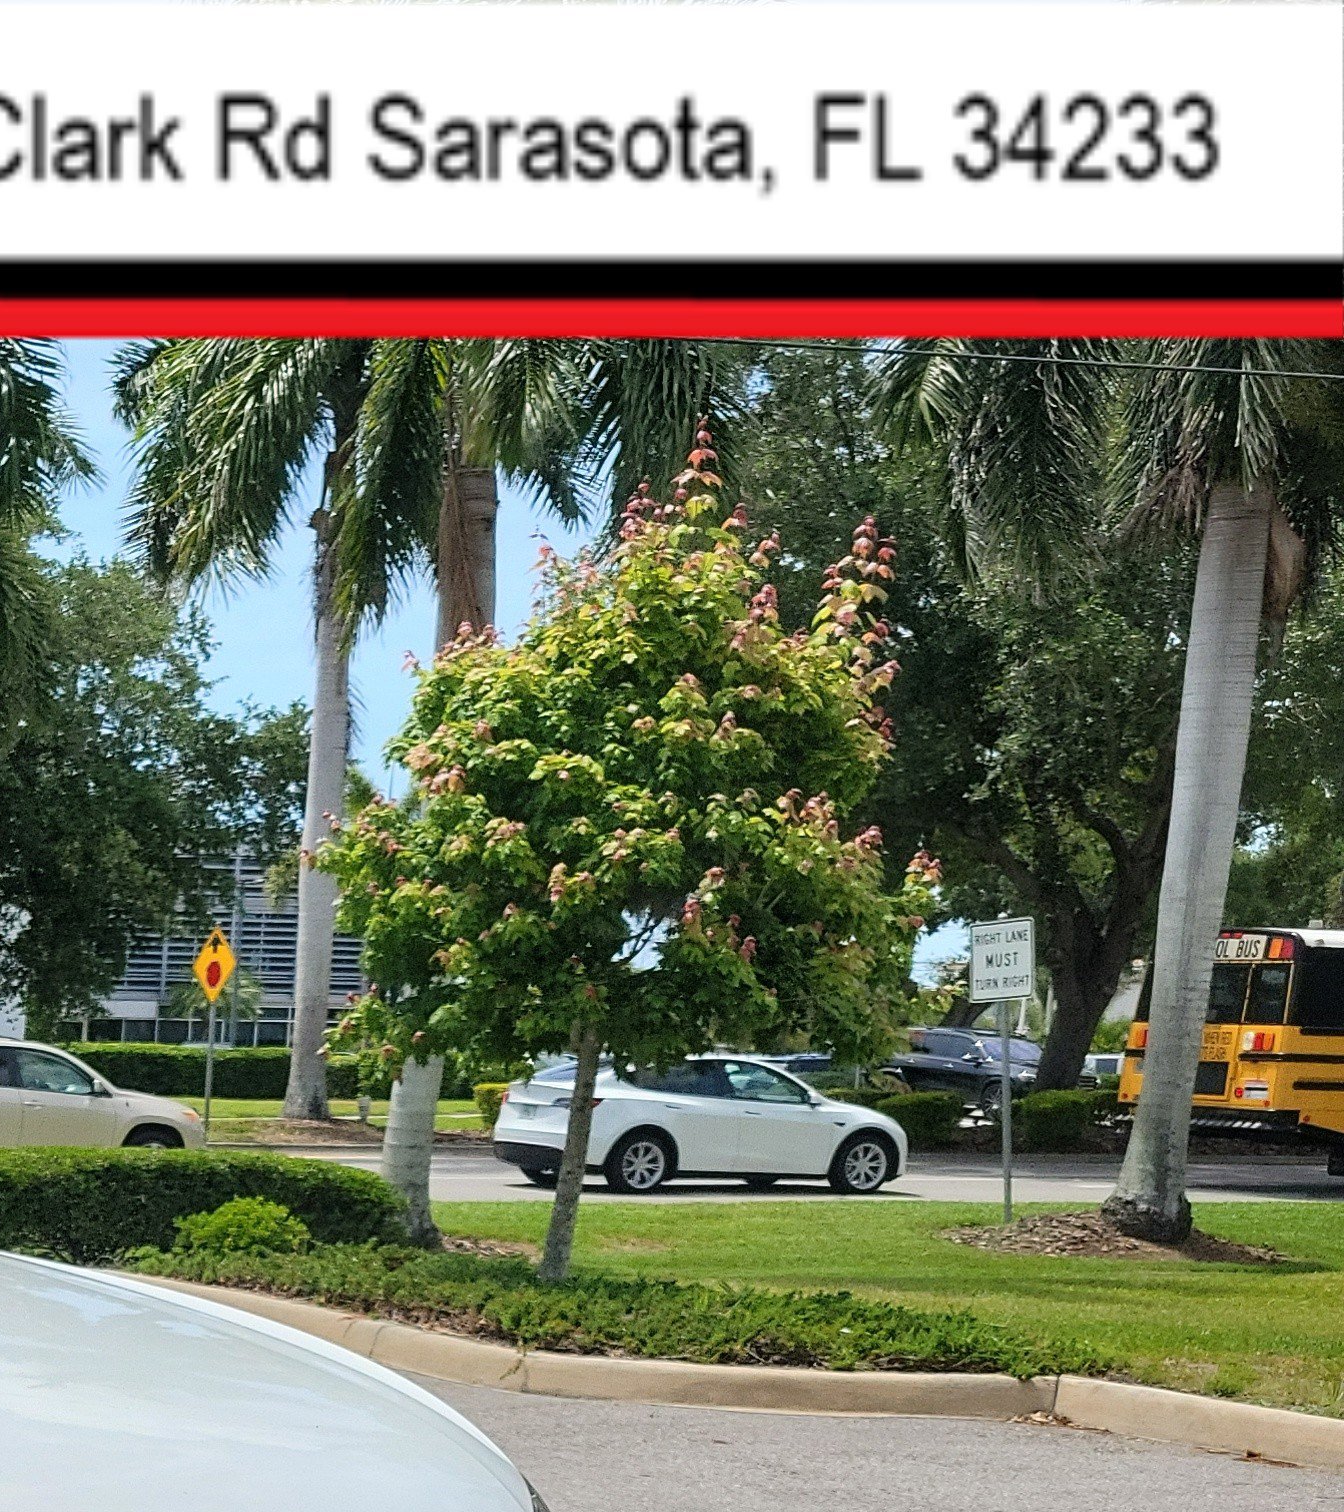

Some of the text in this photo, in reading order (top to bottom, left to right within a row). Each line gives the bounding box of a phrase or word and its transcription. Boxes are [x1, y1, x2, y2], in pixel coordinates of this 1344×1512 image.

[974, 929, 1029, 945] RIGHT LANE
[1235, 939, 1261, 959] BUS
[985, 952, 1018, 968] MUST
[975, 974, 1030, 991] TURN RIGHT
